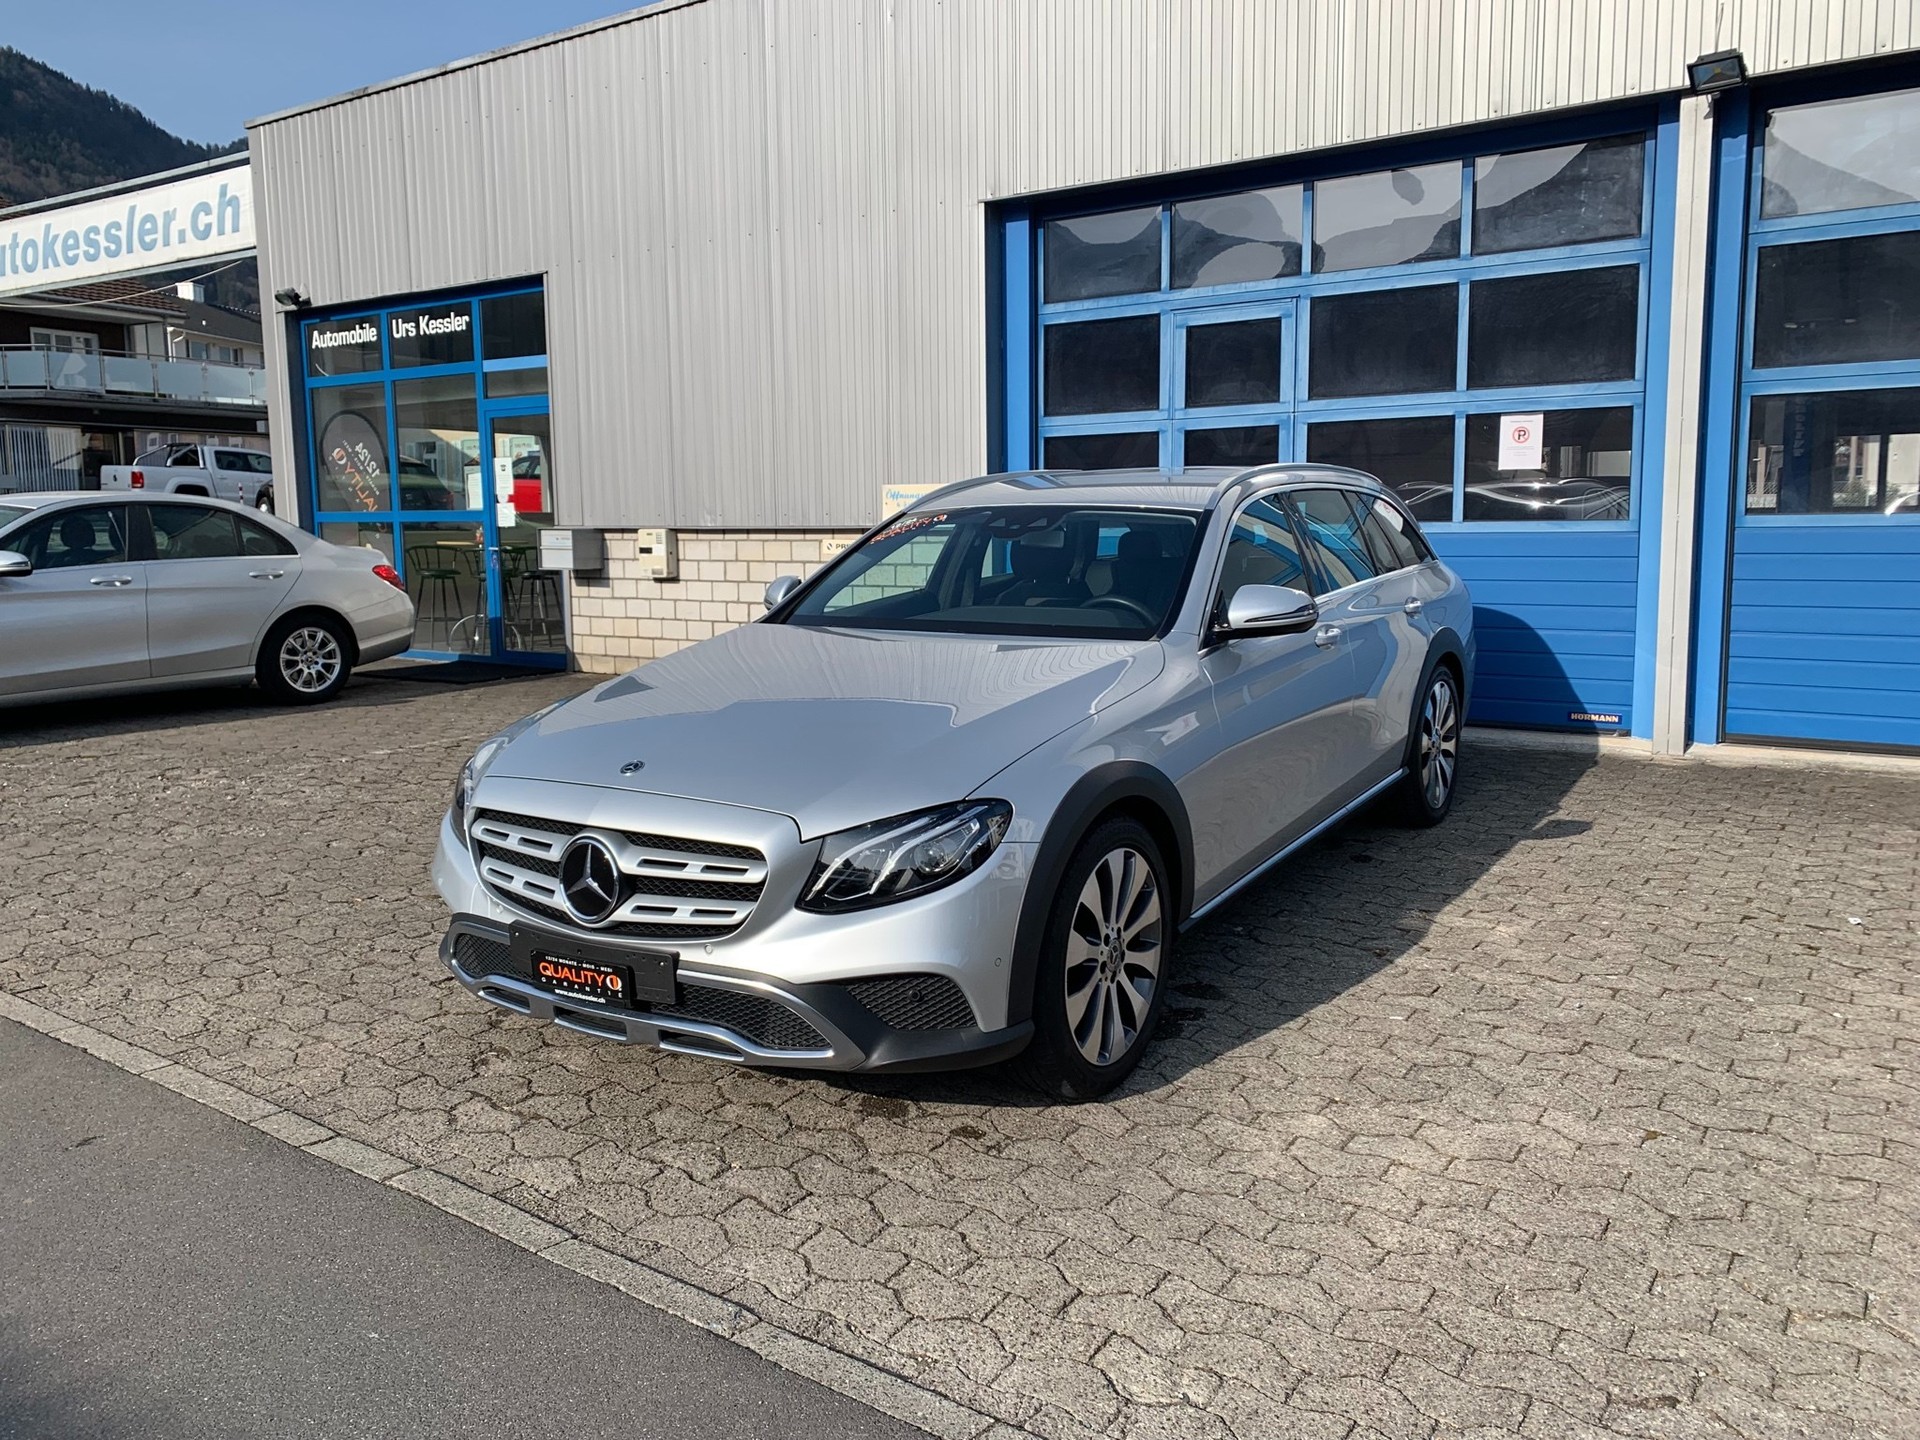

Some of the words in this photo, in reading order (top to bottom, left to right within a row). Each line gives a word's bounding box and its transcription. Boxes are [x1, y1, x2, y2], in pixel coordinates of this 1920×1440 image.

[312, 323, 378, 349] Automobile
[392, 319, 416, 339] Urs
[418, 312, 470, 336] Kessler
[539, 962, 605, 986] QUALITY
